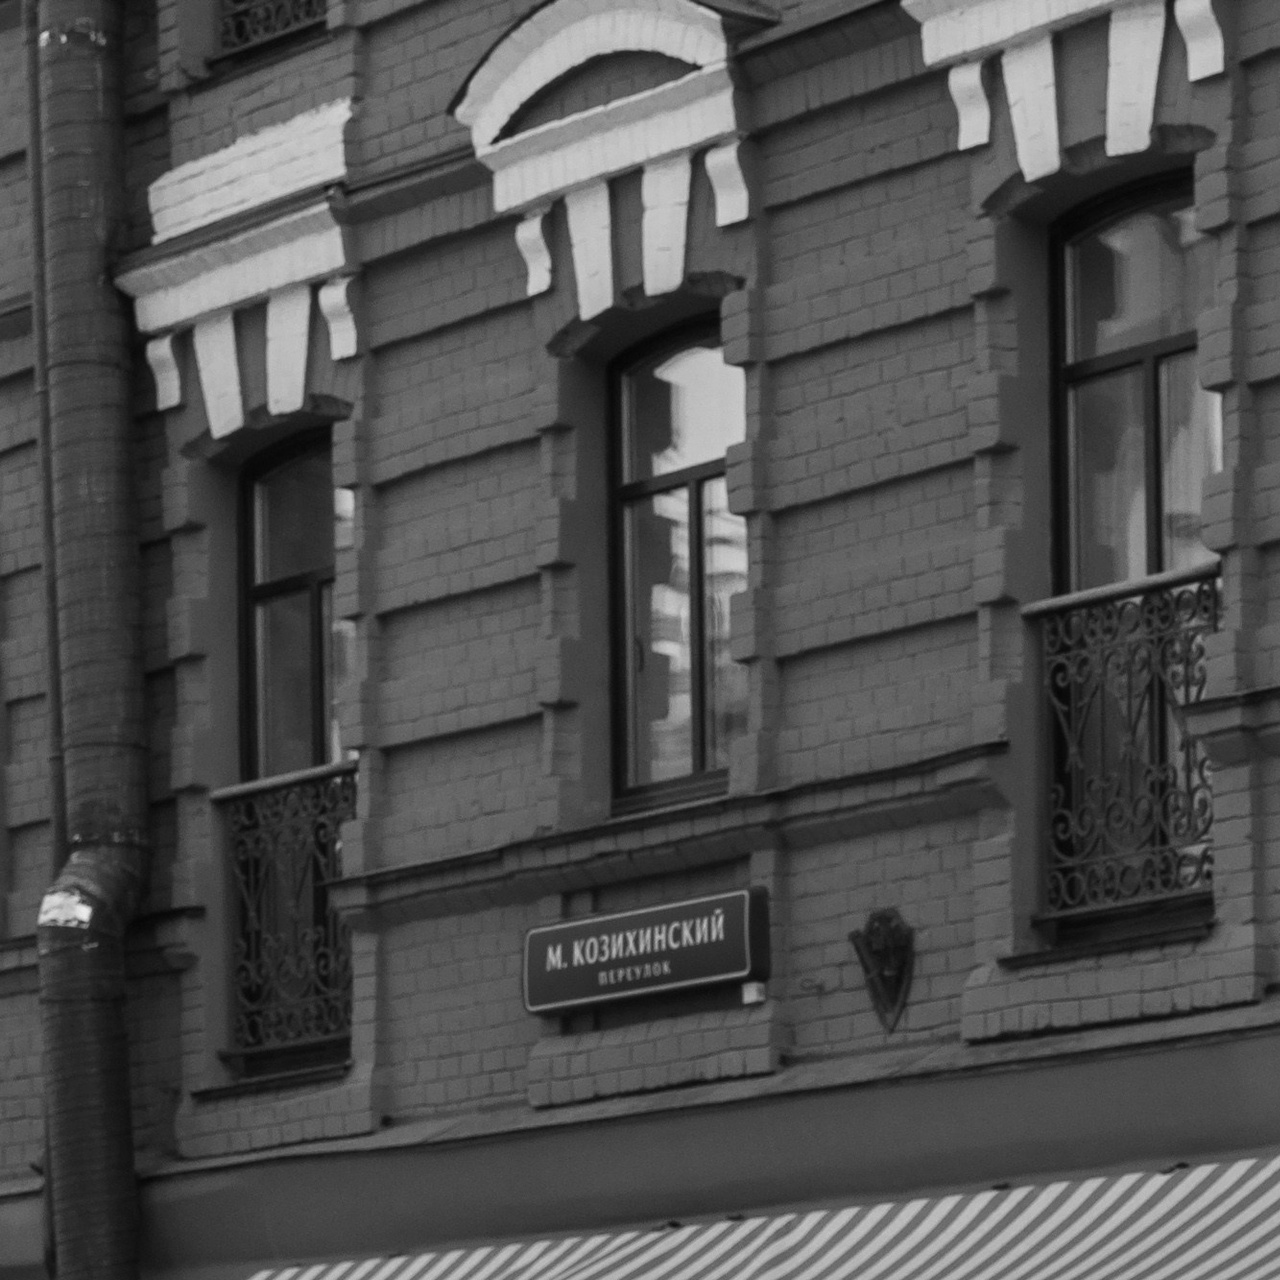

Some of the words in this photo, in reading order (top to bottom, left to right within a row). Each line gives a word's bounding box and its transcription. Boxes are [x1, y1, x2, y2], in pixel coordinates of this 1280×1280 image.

[545, 943, 569, 972] М.
[572, 907, 725, 967] КОЗИХИНСКИЙ
[598, 960, 672, 986] ПЕРЕУЛОК
